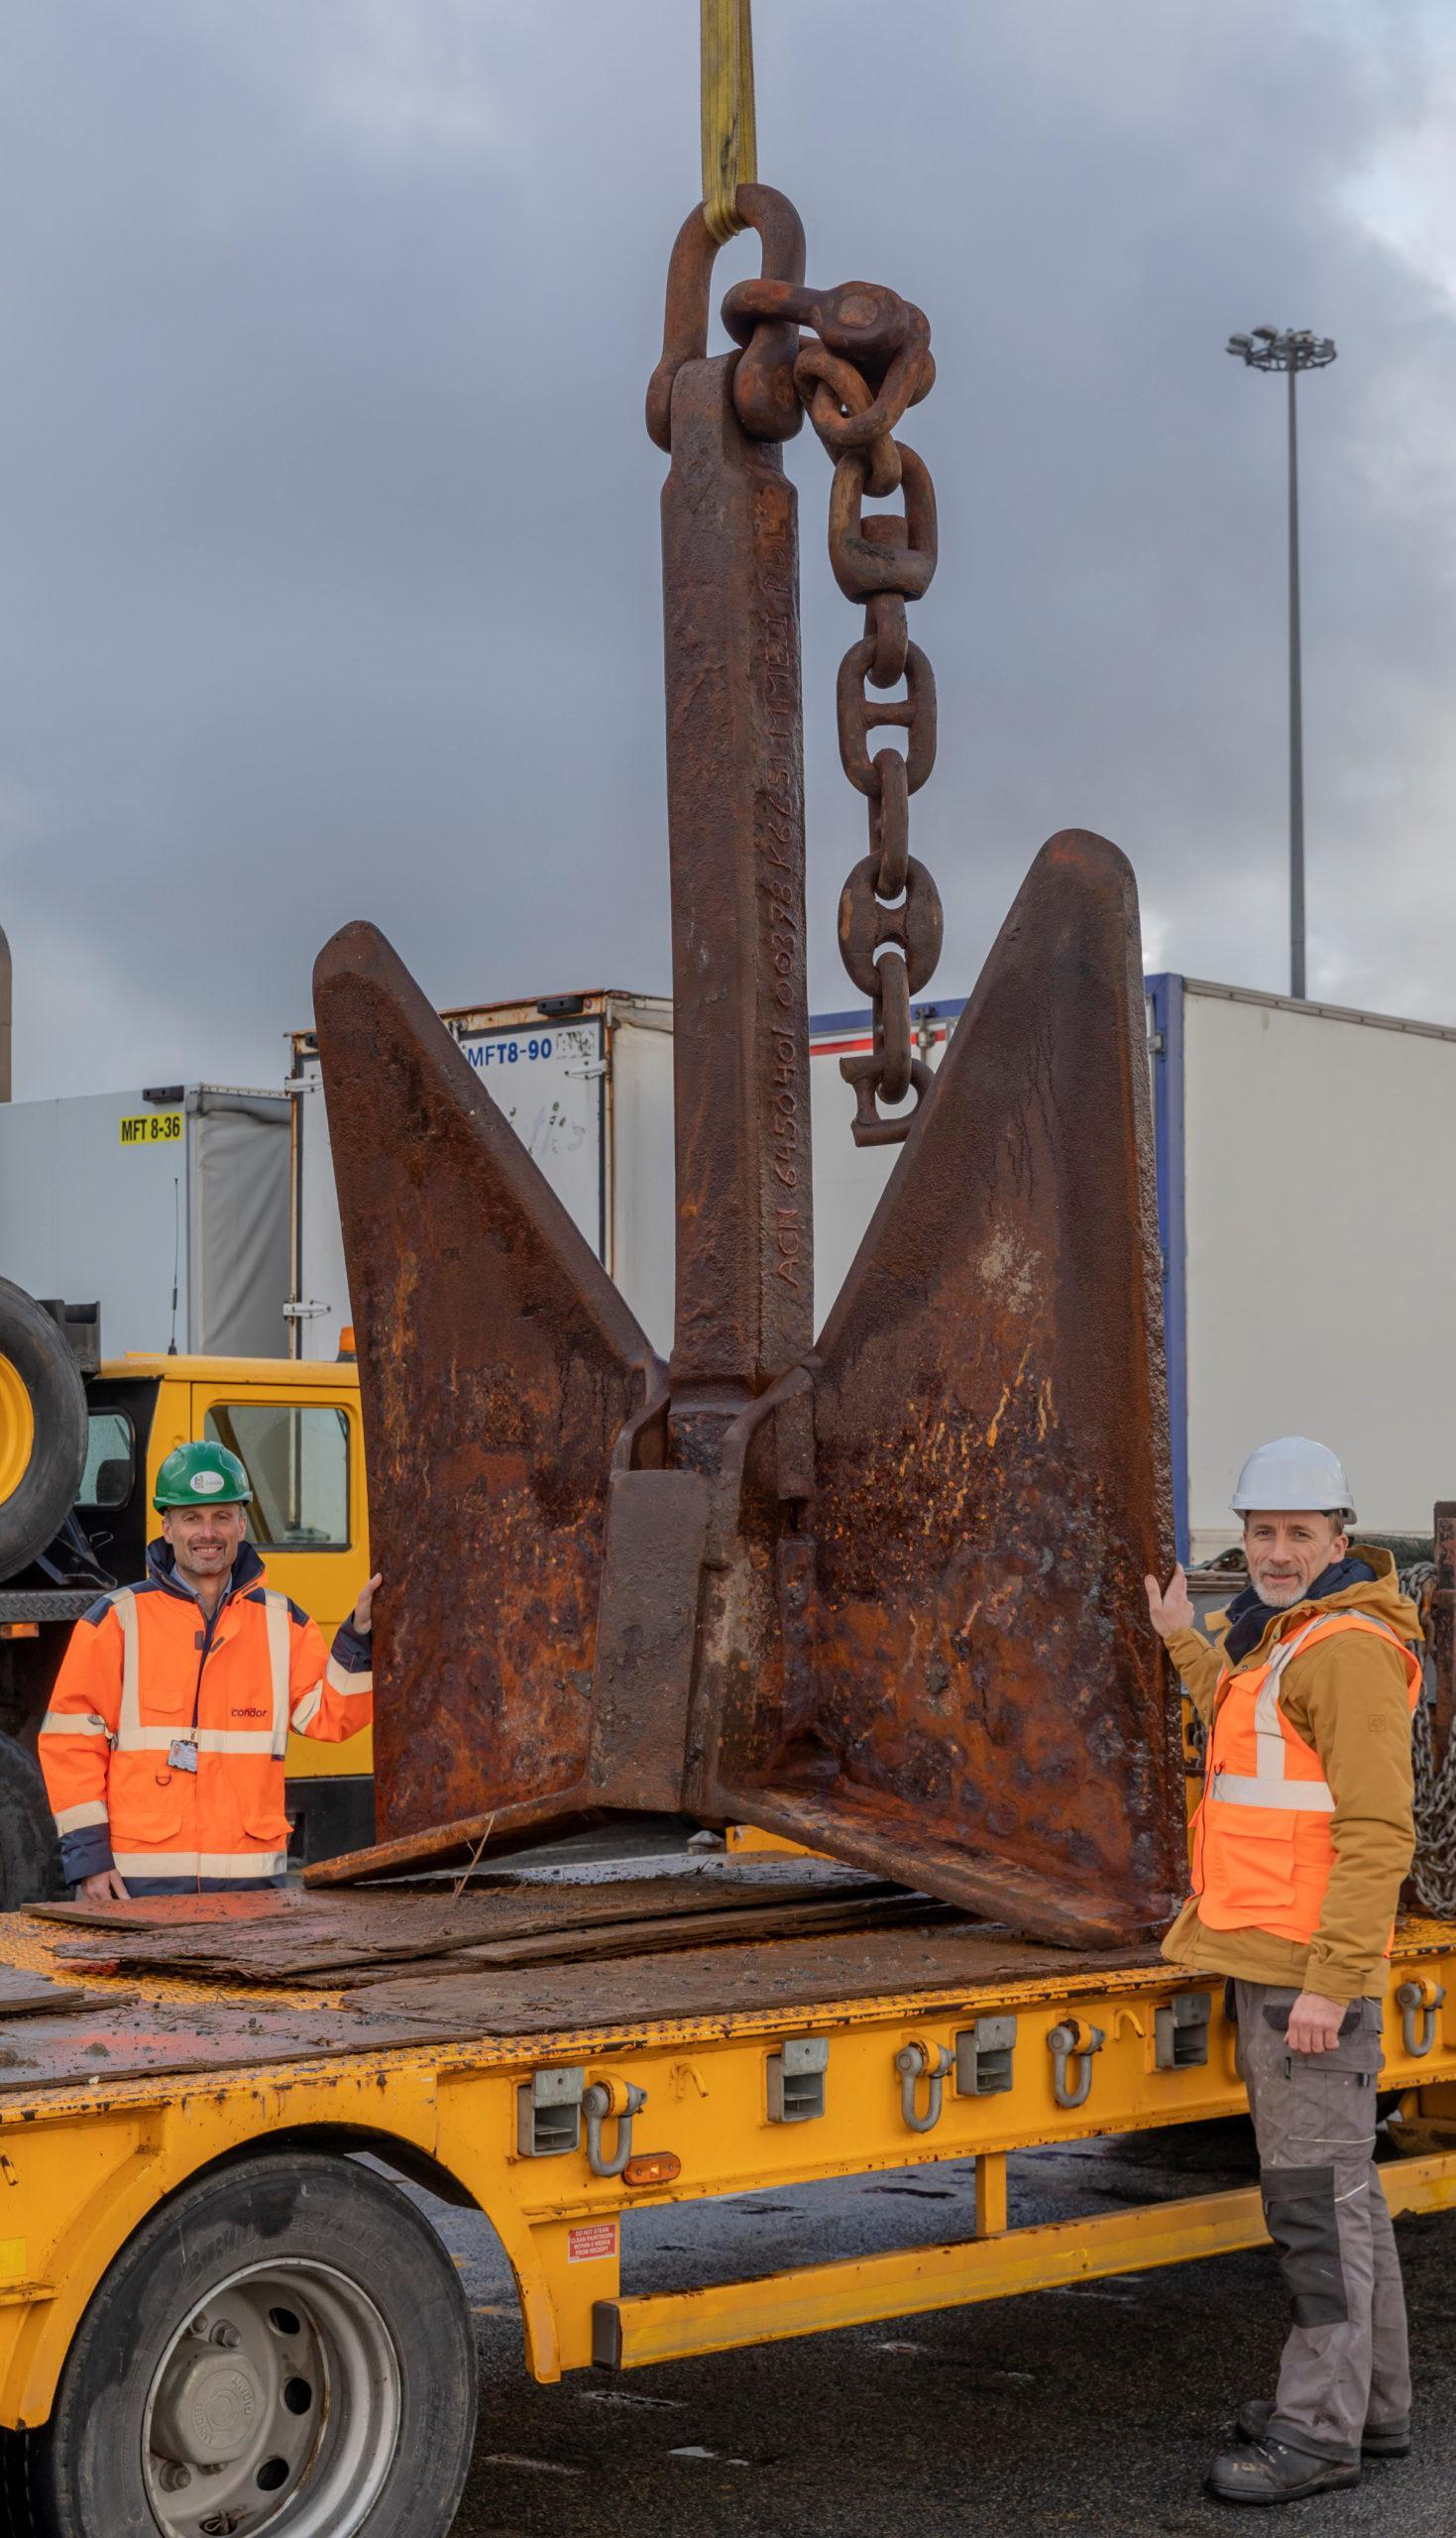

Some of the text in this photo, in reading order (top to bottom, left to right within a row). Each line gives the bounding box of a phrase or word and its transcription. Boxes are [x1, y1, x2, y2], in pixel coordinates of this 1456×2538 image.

[468, 1038, 552, 1067] MFT8-90
[122, 1116, 180, 1141] MFT 8-36
[776, 1209, 800, 1289] ACN
[231, 1707, 268, 1718] condor
[594, 2226, 610, 2235] STEAM
[571, 2236, 587, 2245] CLEAN
